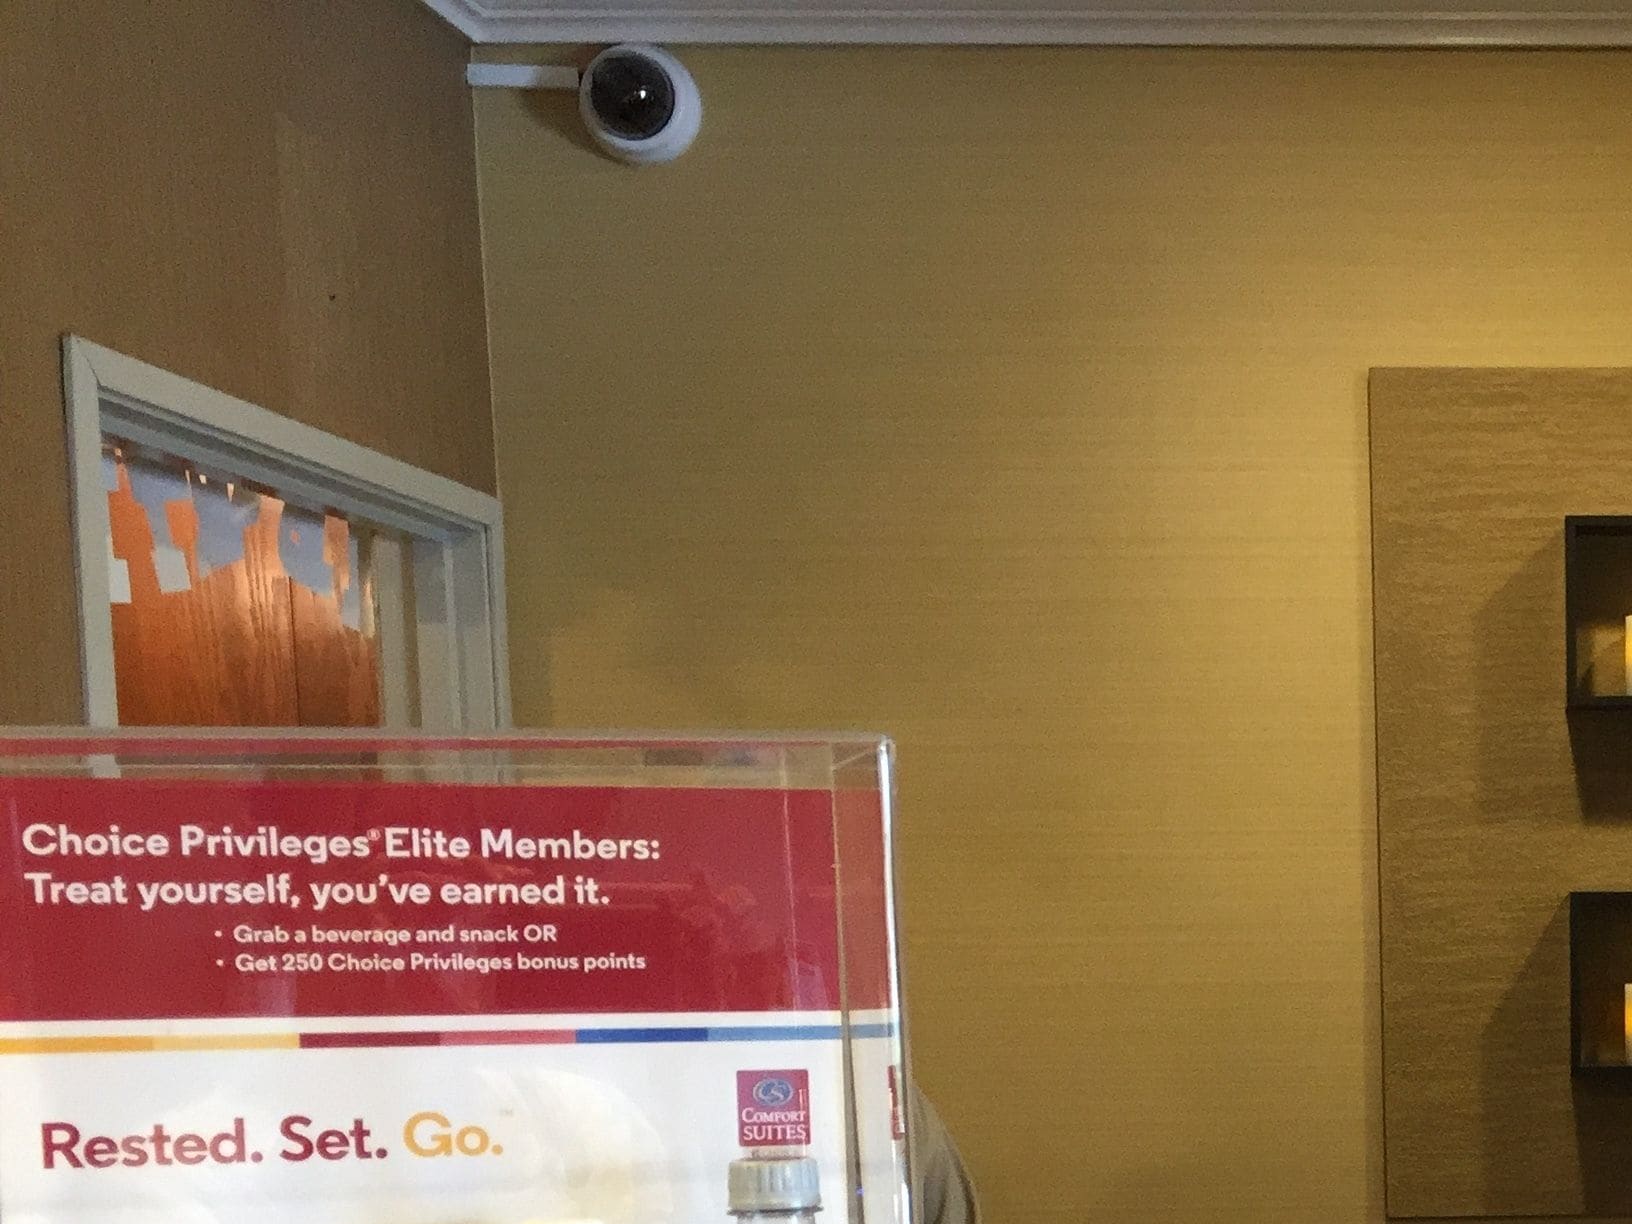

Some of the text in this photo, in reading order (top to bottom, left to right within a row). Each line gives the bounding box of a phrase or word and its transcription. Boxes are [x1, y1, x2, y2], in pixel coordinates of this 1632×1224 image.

[22, 824, 169, 856] Choice
[384, 827, 470, 859] Elite
[480, 828, 660, 860] Members:
[24, 873, 610, 911] Treat yourself, you've earned it.
[233, 924, 557, 946] Grab a beverage and snack OR
[235, 952, 647, 974] Get 250 Choice Privileges bonus points
[742, 1107, 806, 1124] COMFORT
[41, 1111, 504, 1169] Rested. Set. Go.
[743, 1124, 806, 1140] SUITES
